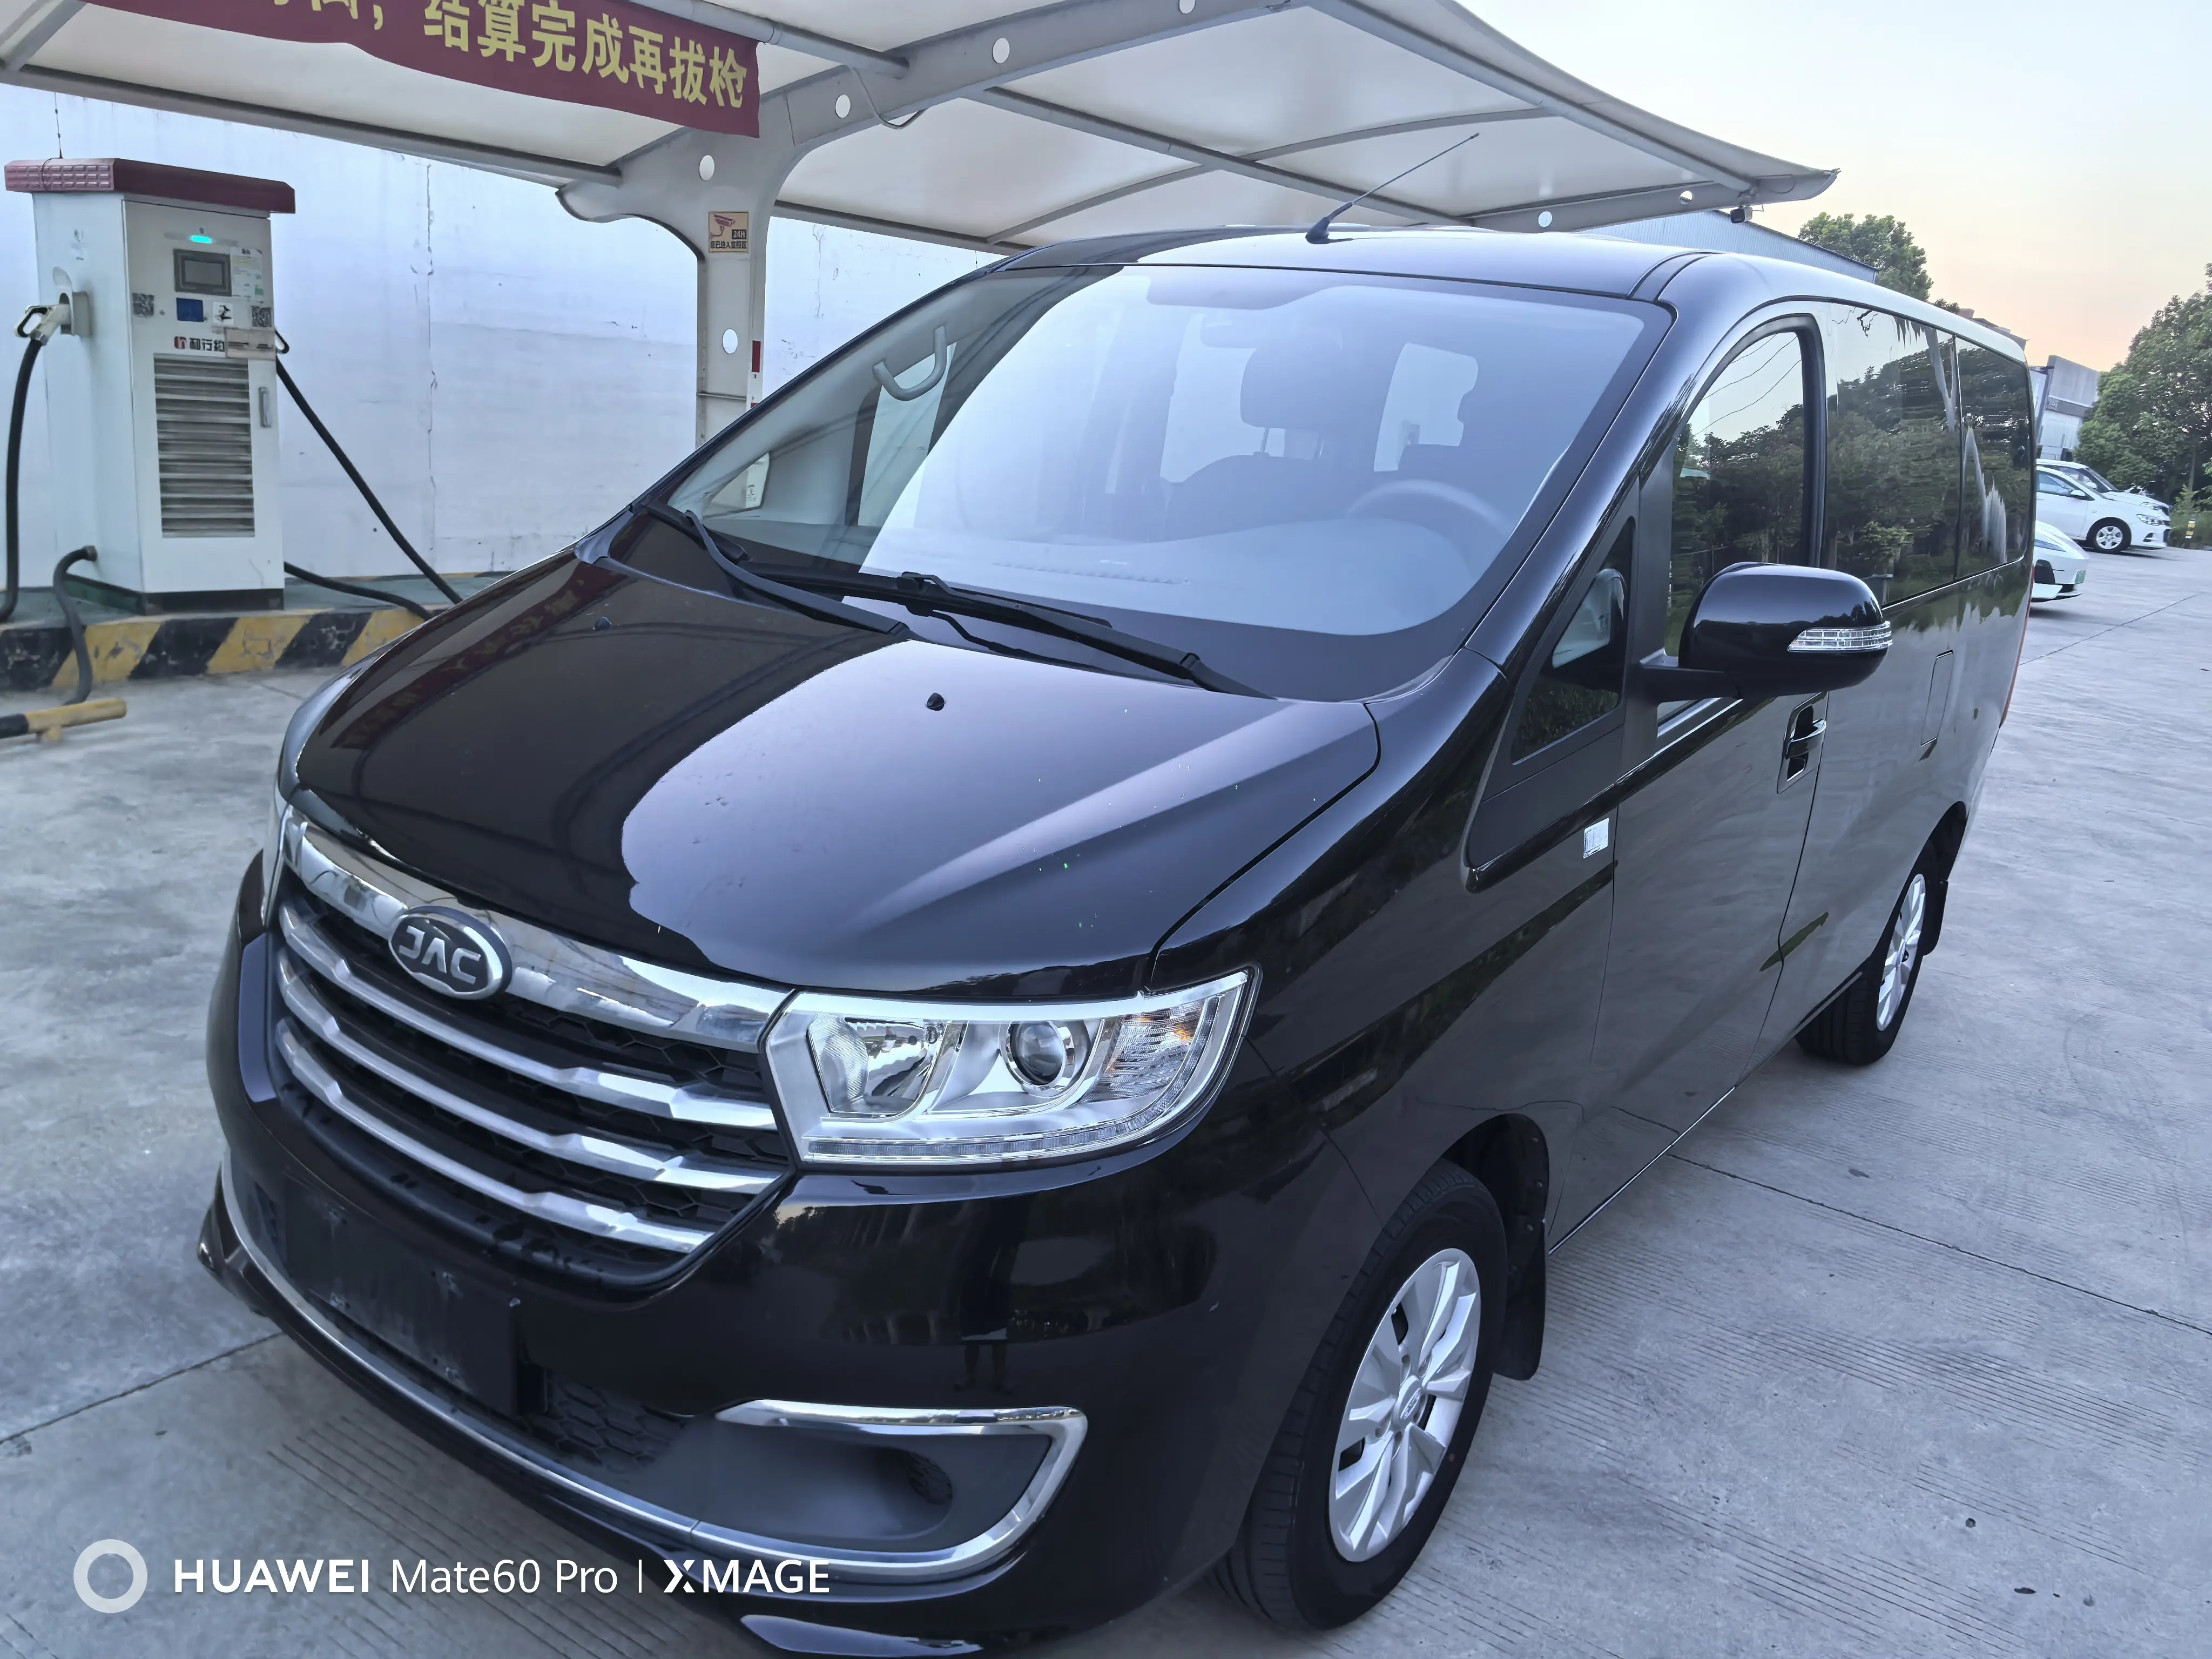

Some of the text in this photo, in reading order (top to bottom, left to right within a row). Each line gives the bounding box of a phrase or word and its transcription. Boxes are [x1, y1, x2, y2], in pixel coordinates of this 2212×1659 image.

[274, 0, 747, 108] ，结算完成再拔枪
[399, 925, 481, 984] JAC
